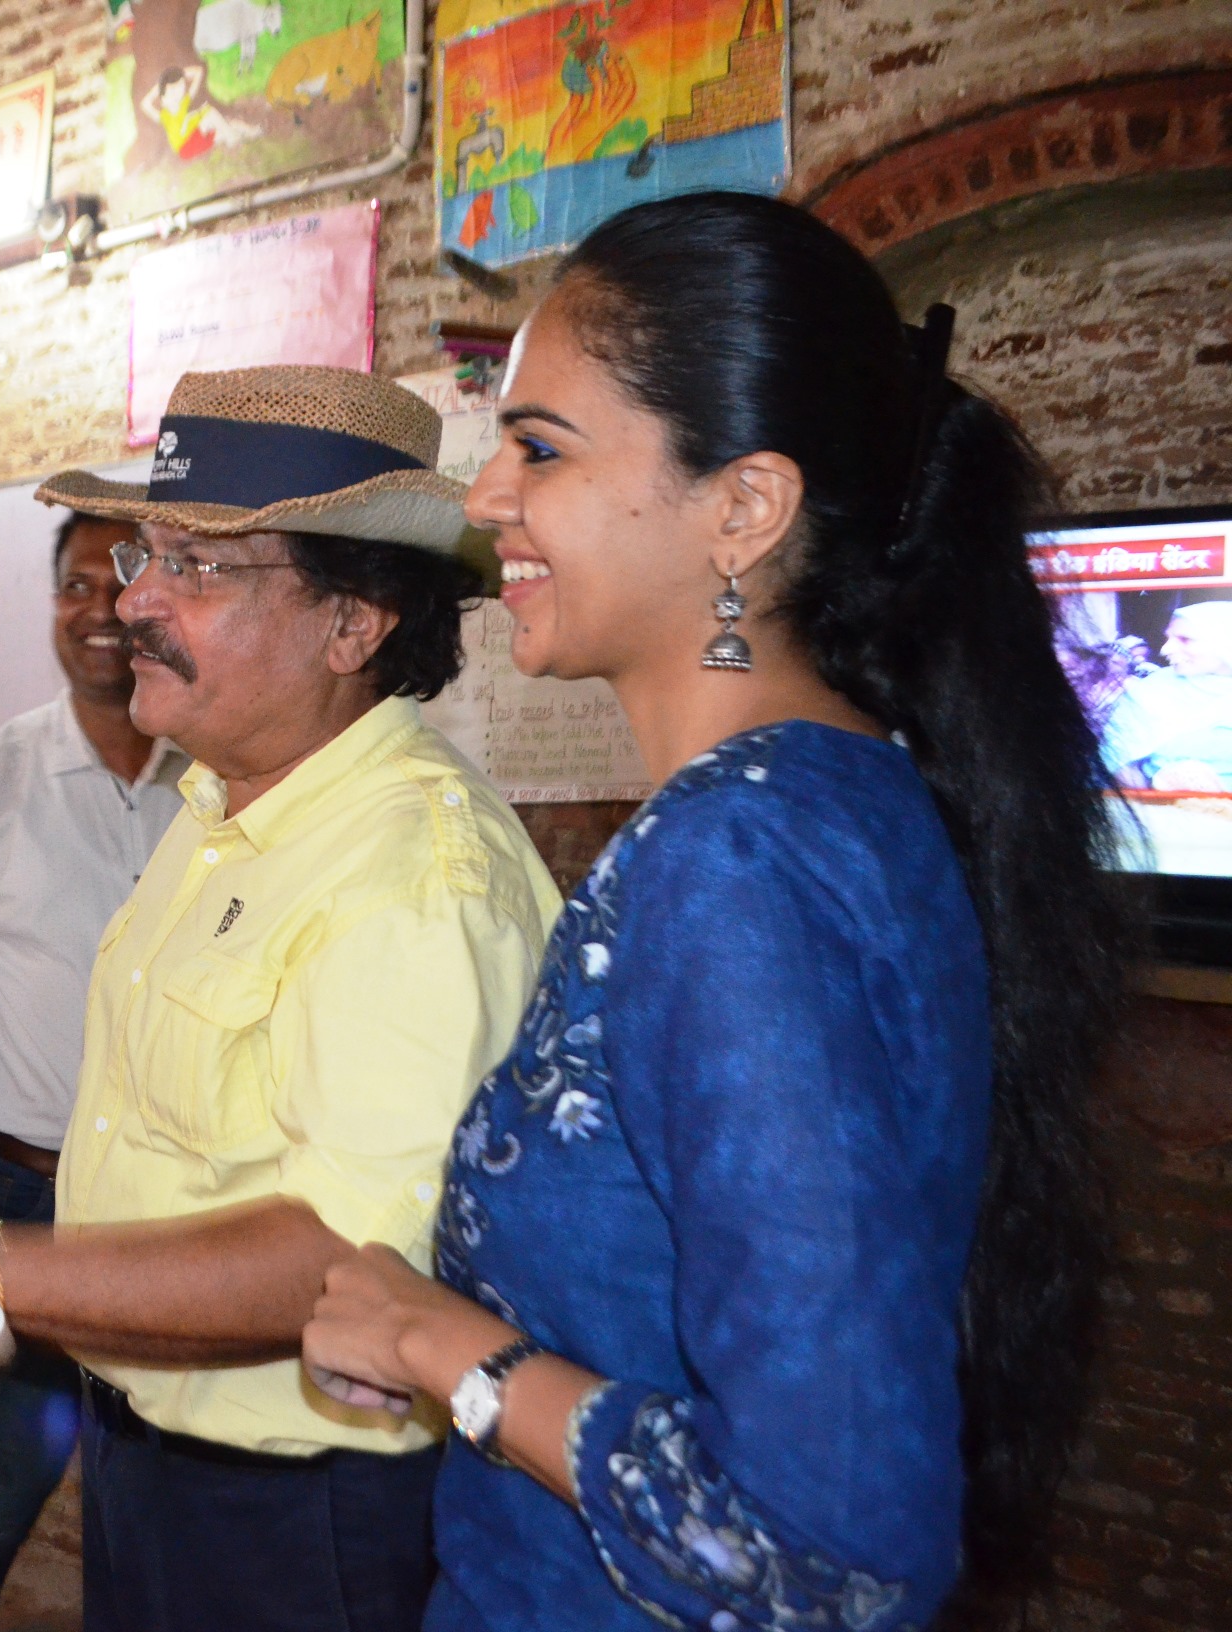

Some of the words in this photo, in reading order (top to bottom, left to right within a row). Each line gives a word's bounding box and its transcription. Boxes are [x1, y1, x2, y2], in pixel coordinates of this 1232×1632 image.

[168, 457, 192, 471] HILLS
[1093, 546, 1158, 575] इंडिया
[1159, 543, 1211, 571] सेंटर
